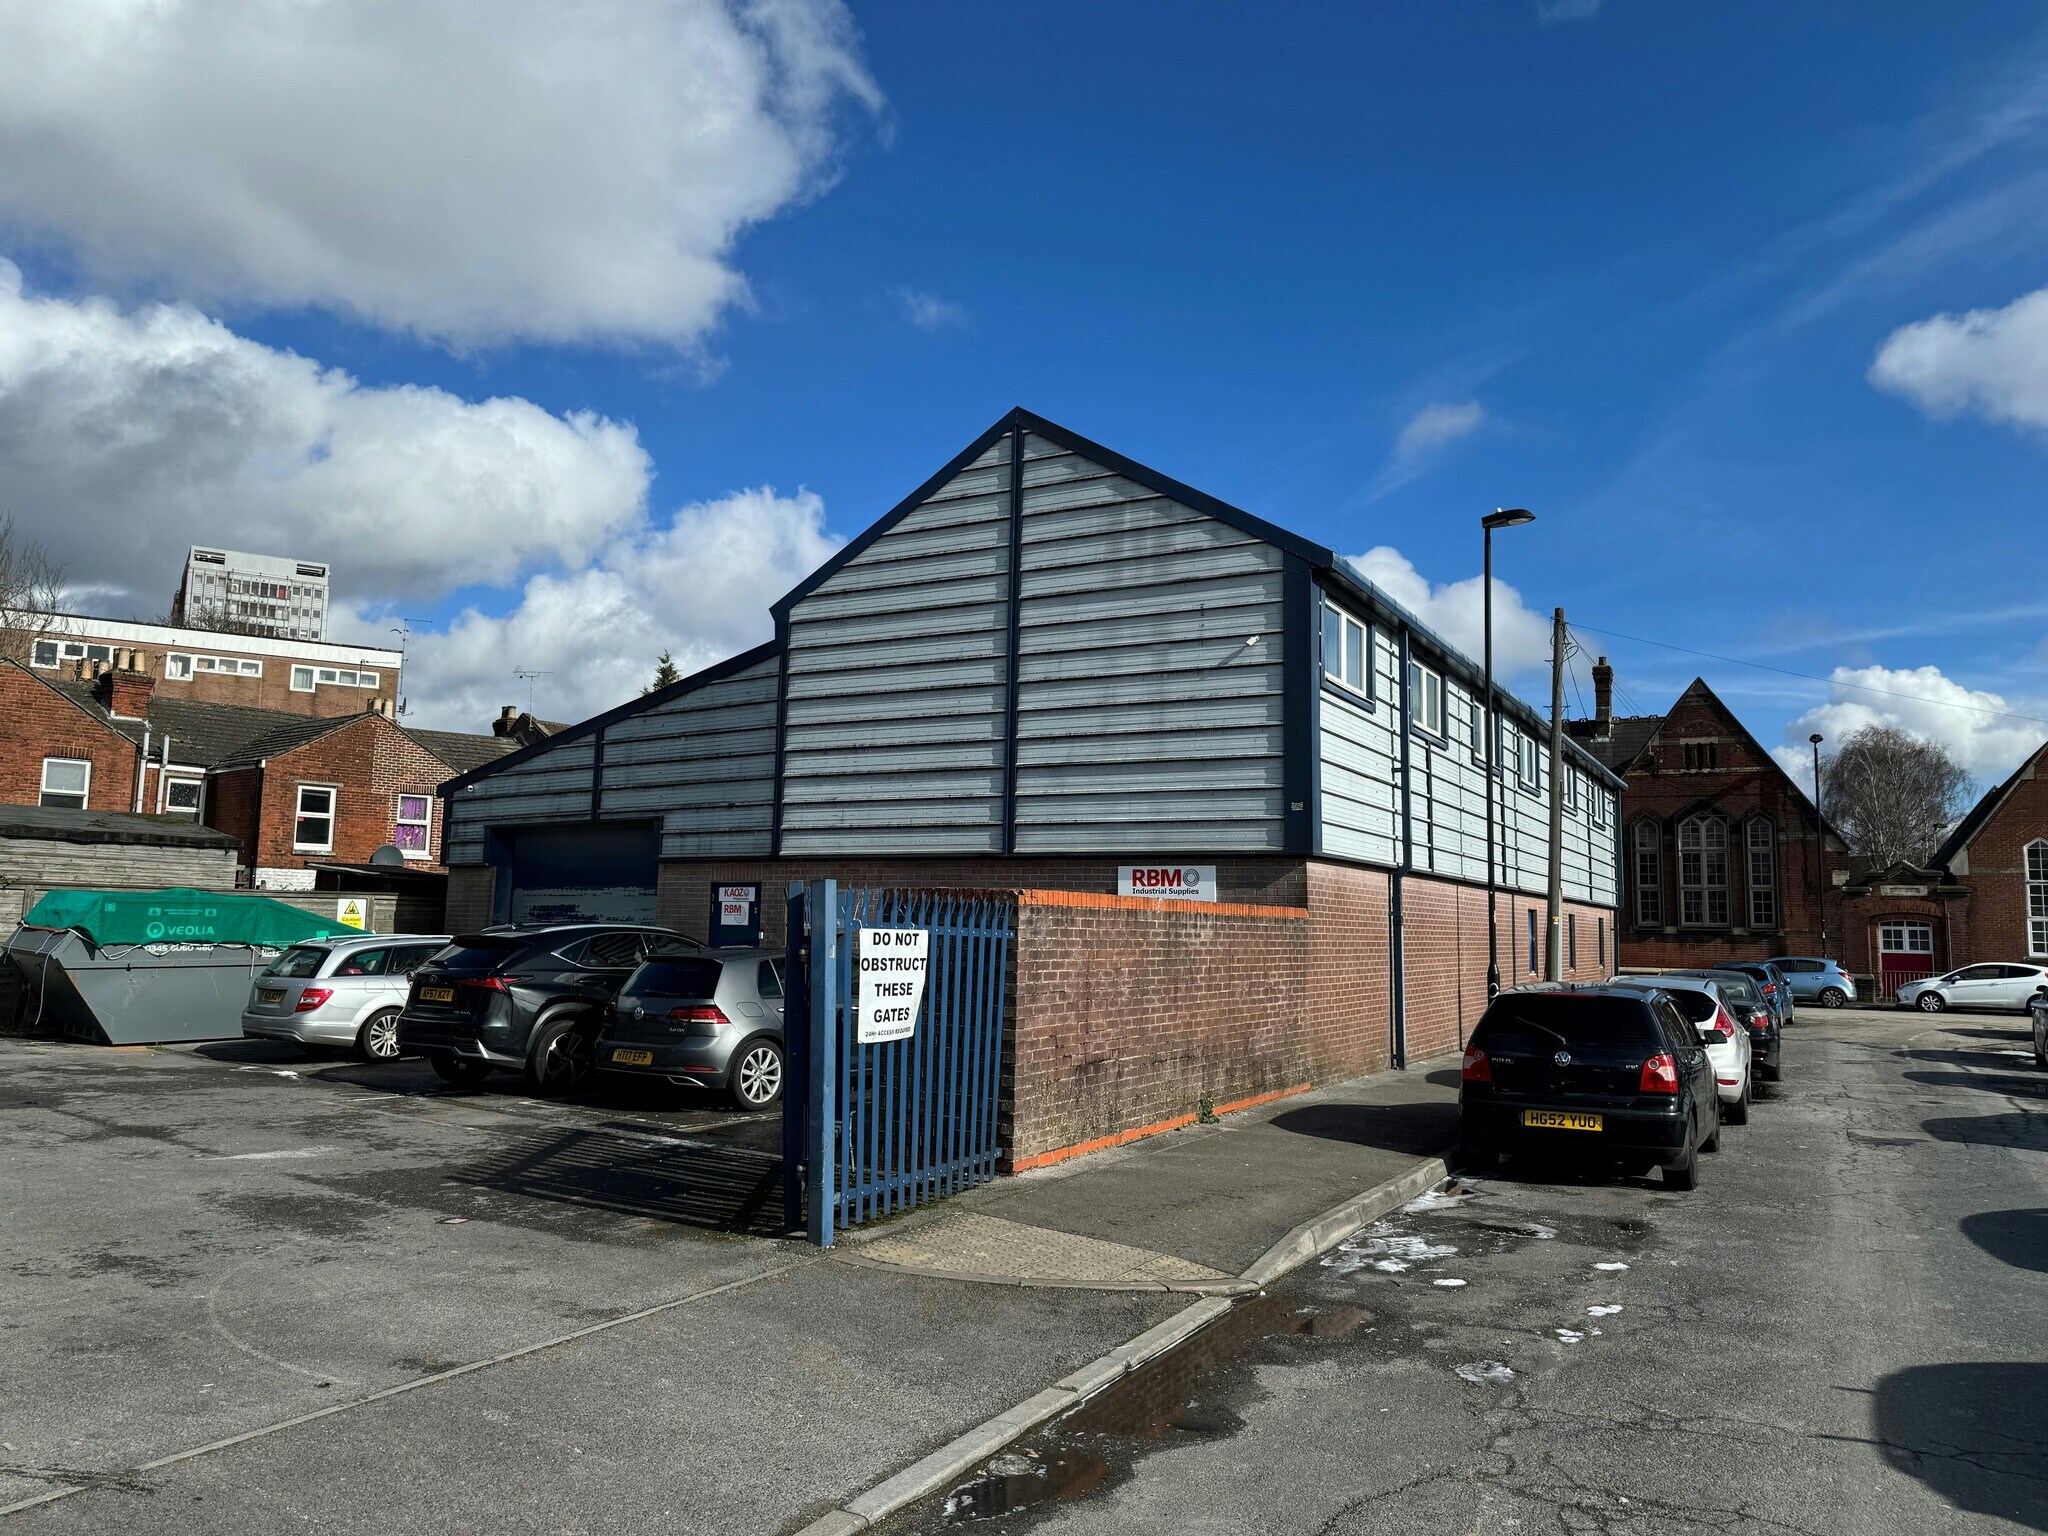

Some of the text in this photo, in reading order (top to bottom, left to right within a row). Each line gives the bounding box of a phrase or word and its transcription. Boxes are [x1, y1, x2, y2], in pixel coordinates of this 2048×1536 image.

[1132, 869, 1182, 887] RBM
[1168, 888, 1200, 896] Supplies
[723, 904, 742, 914] RBM
[167, 925, 215, 935] VEOLIA
[873, 932, 919, 946] DO NOT
[861, 957, 927, 971] OBSTRUCT
[875, 982, 913, 997] THESE
[874, 1007, 910, 1023] GATES
[1530, 1112, 1596, 1128] HG52 YUO
